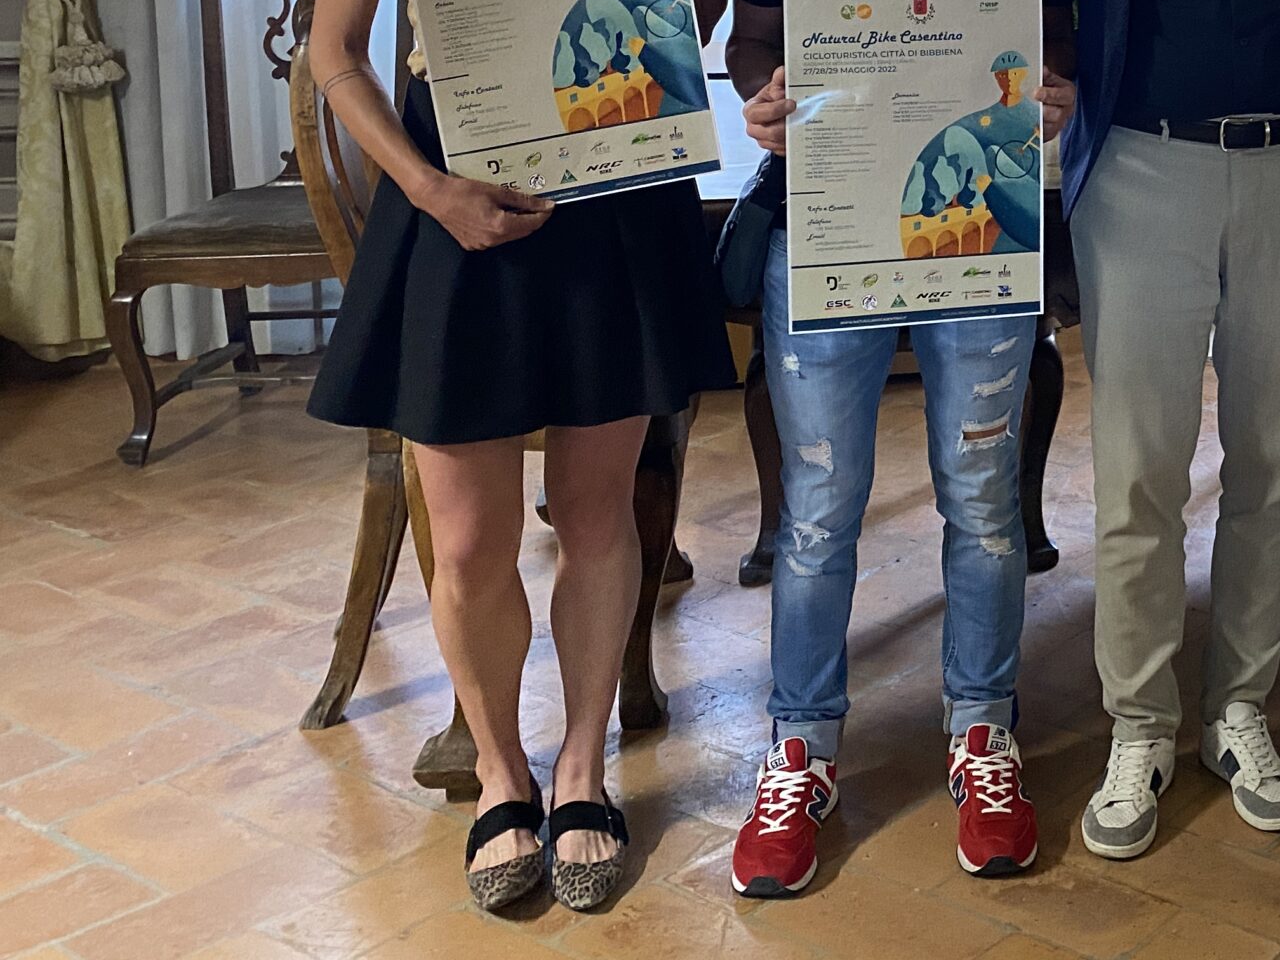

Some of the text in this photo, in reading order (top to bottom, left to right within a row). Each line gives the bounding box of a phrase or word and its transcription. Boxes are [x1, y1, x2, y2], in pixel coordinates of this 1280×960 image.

[802, 30, 963, 49] Natural Bike Casentino
[804, 52, 878, 60] CICLOTURISTICA
[920, 48, 963, 56] BIBBIENA
[803, 66, 838, 76] 27/28/29
[840, 66, 876, 74] MAGGIO
[586, 160, 623, 172] NRC
[916, 290, 952, 300] NRC
